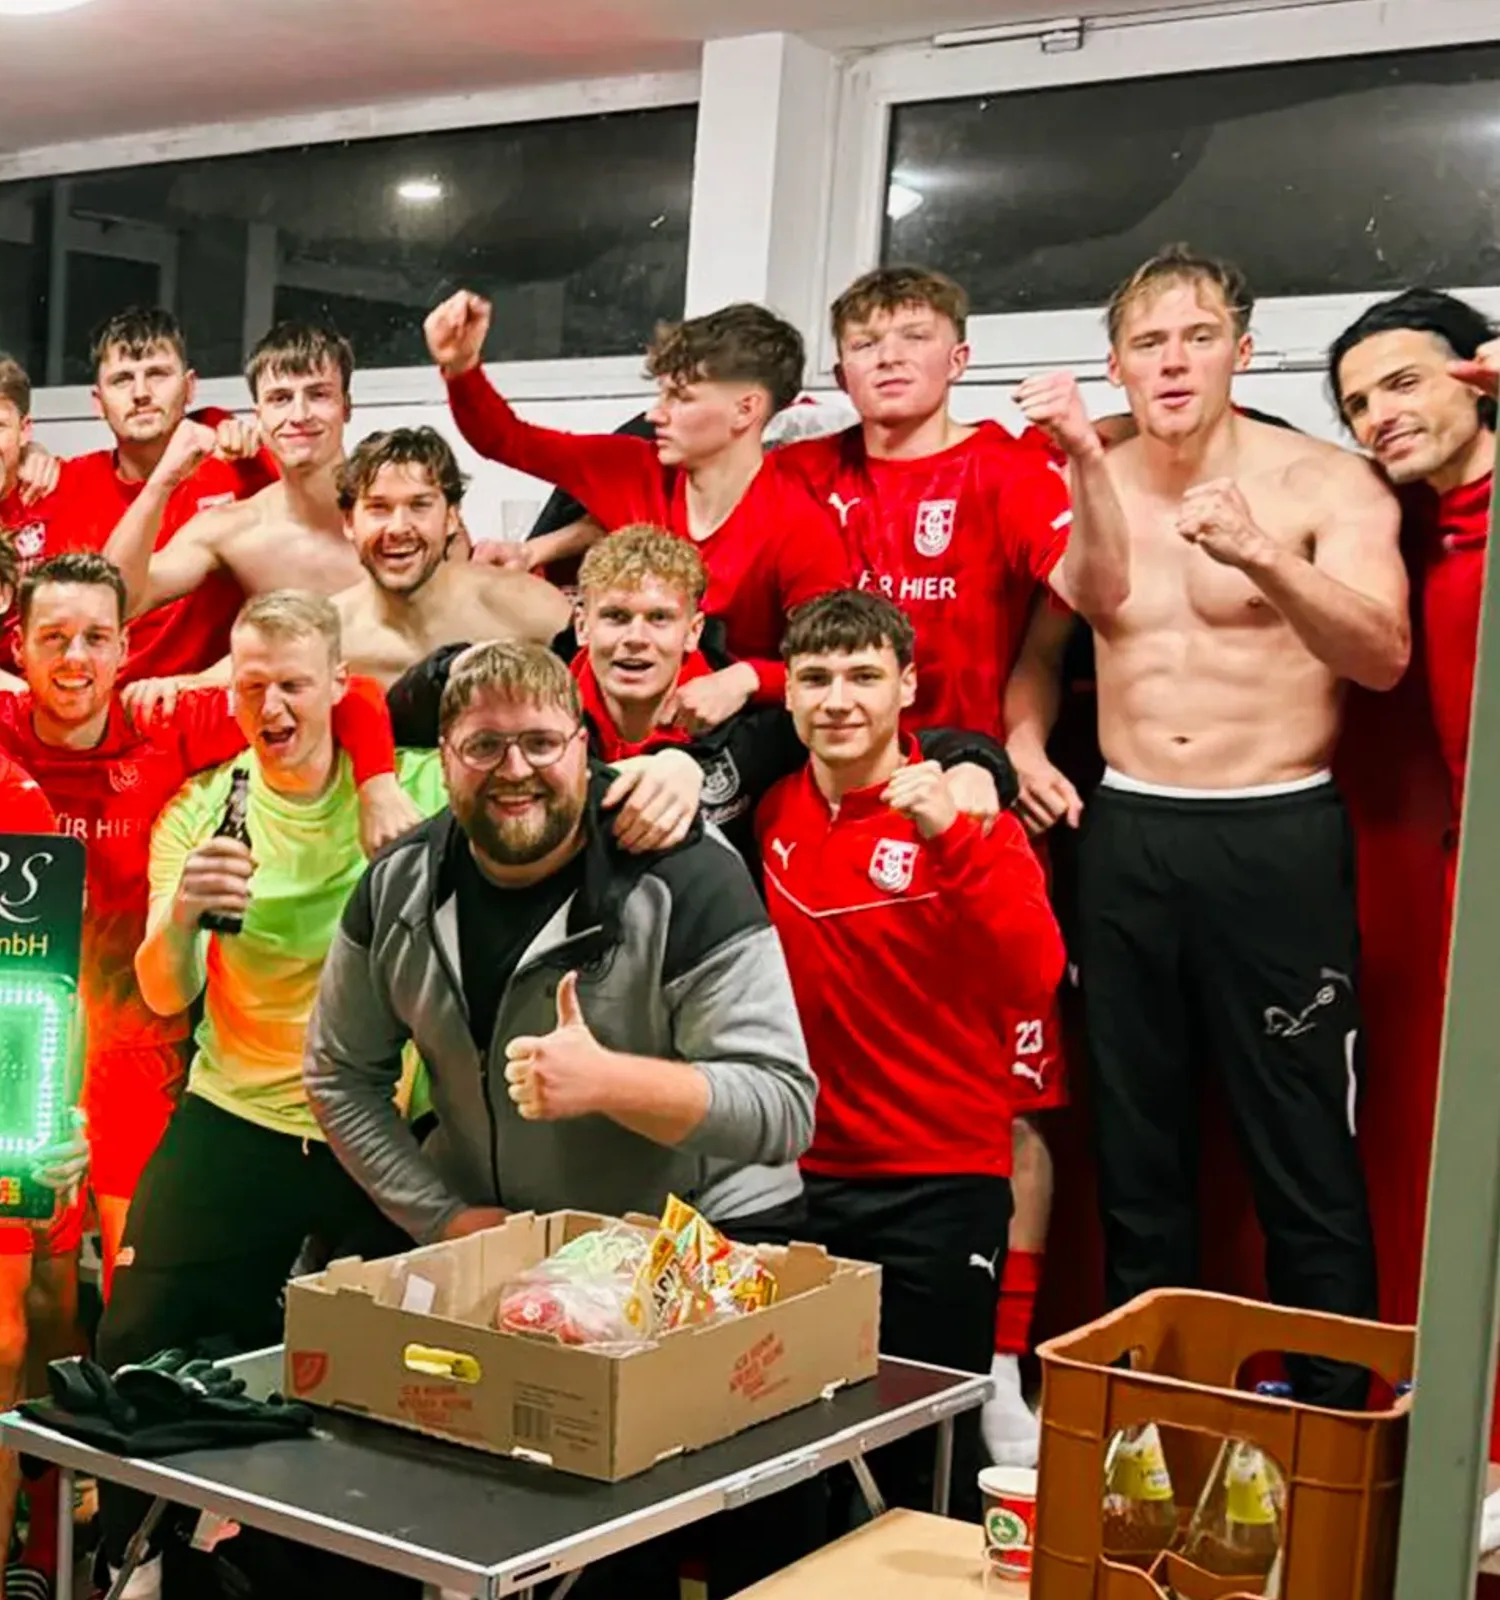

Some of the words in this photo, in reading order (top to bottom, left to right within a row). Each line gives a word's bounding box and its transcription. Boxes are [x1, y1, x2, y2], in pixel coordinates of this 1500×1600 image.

[858, 569, 893, 599] FR
[900, 576, 957, 600] HIER
[55, 812, 88, 839] ÜR
[1015, 1019, 1043, 1056] 23
